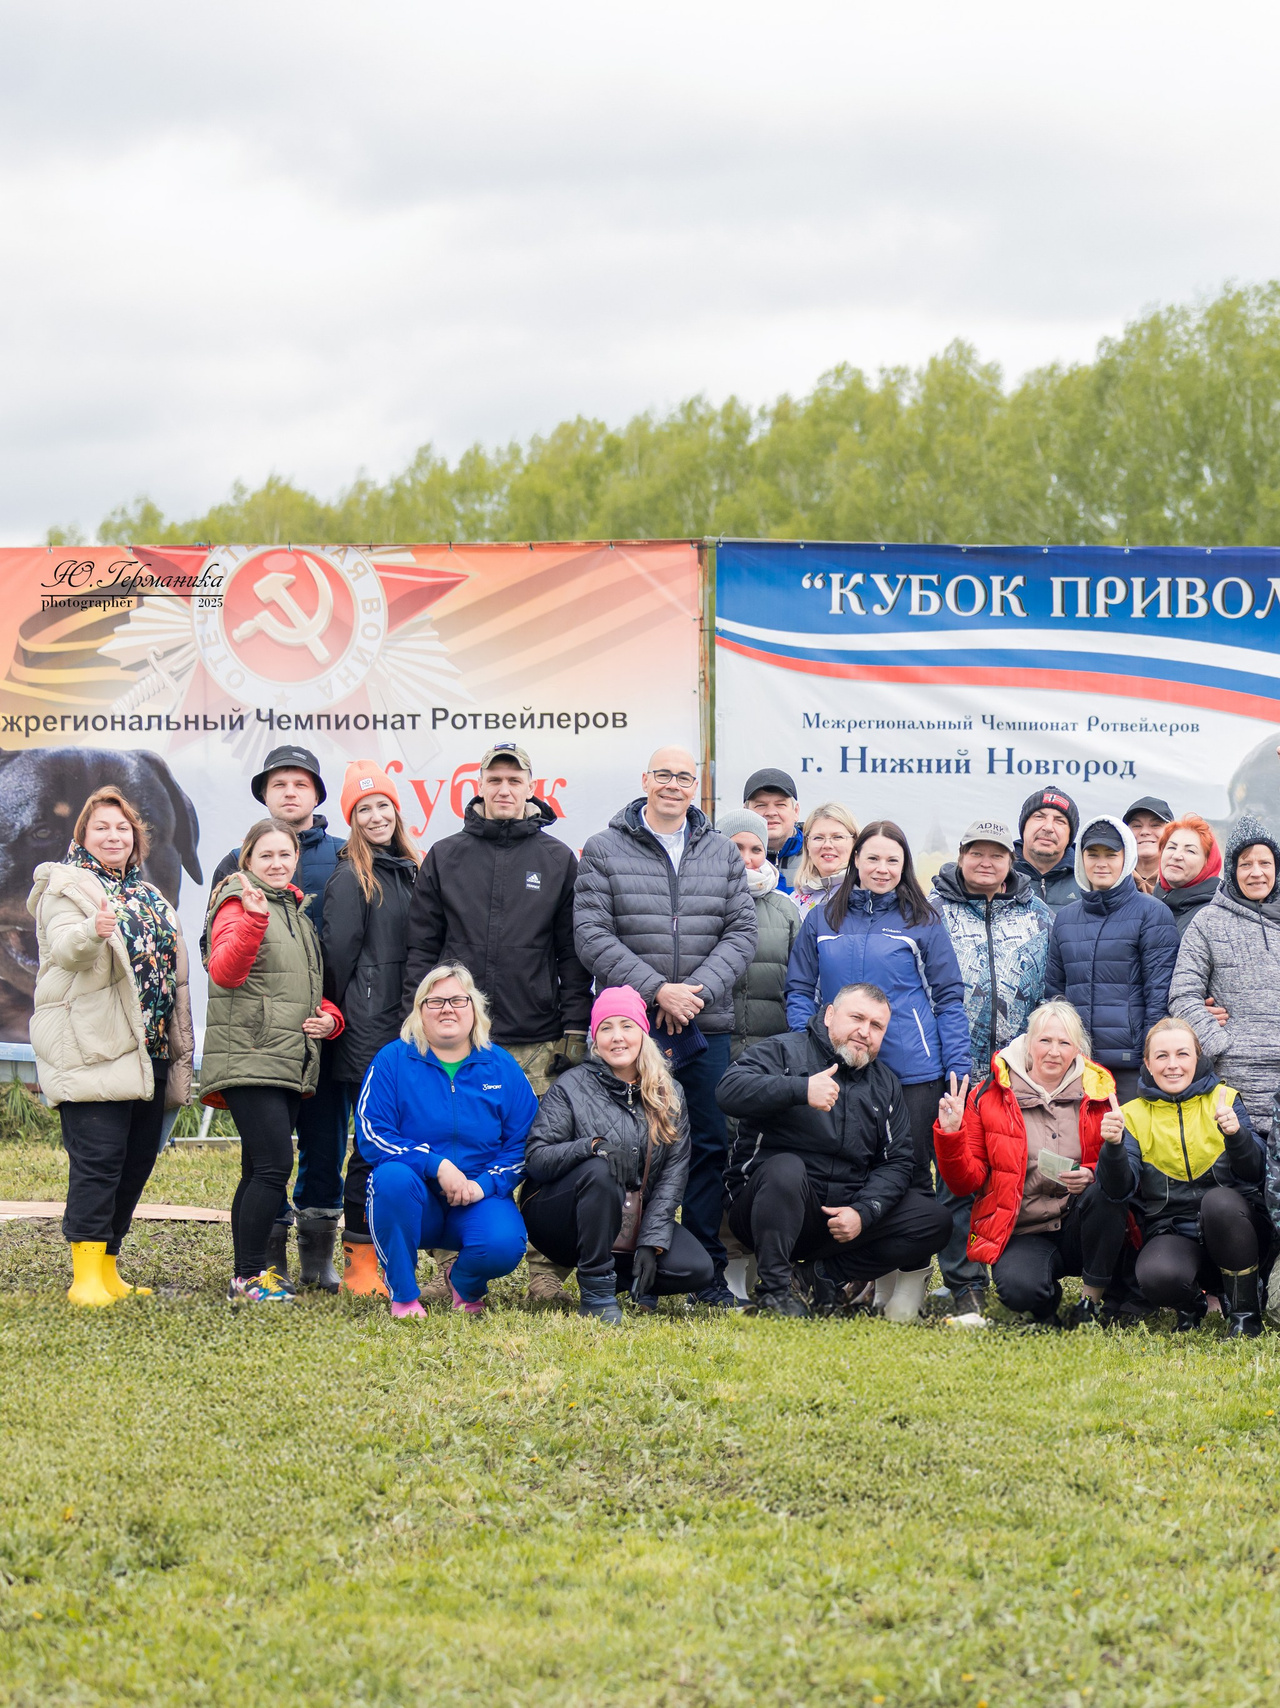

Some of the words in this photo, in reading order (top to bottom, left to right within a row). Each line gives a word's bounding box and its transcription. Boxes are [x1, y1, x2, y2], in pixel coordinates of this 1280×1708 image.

[1, 707, 245, 738] жрегиональный
[255, 708, 422, 731] Чемпионат
[431, 706, 628, 735] Ротвейлеров
[802, 712, 973, 734] Межрегиональный
[981, 714, 1079, 732] Чемпионат
[1086, 715, 1200, 736] Ротвейлеров
[801, 756, 823, 773] г.
[839, 746, 972, 775] Нижний
[986, 747, 1137, 782] Новгород
[347, 760, 568, 838] убк
